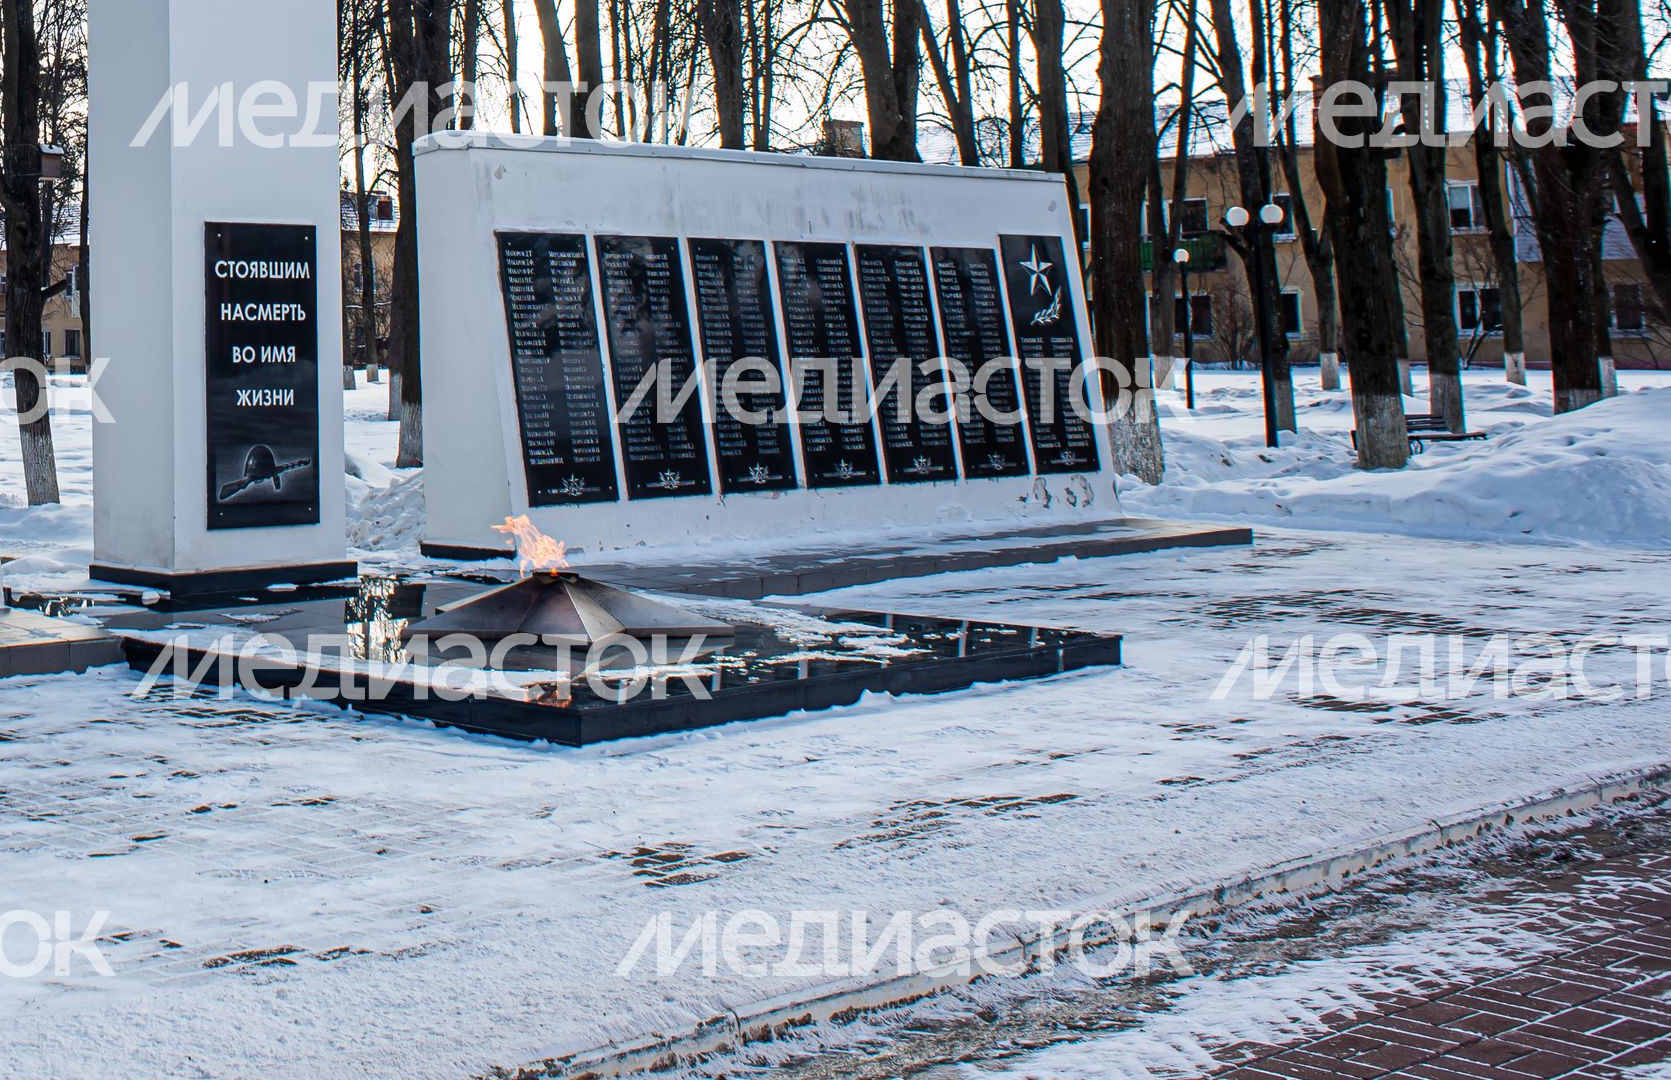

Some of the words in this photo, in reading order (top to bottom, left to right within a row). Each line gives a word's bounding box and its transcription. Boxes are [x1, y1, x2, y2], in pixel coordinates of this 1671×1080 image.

[214, 260, 310, 279] СТОЯВШИМ
[221, 303, 306, 321] НАСМЕРТЬ
[232, 346, 255, 363] ВО
[261, 346, 295, 363] ИМЯ
[236, 389, 294, 406] ЖИЗНИ
